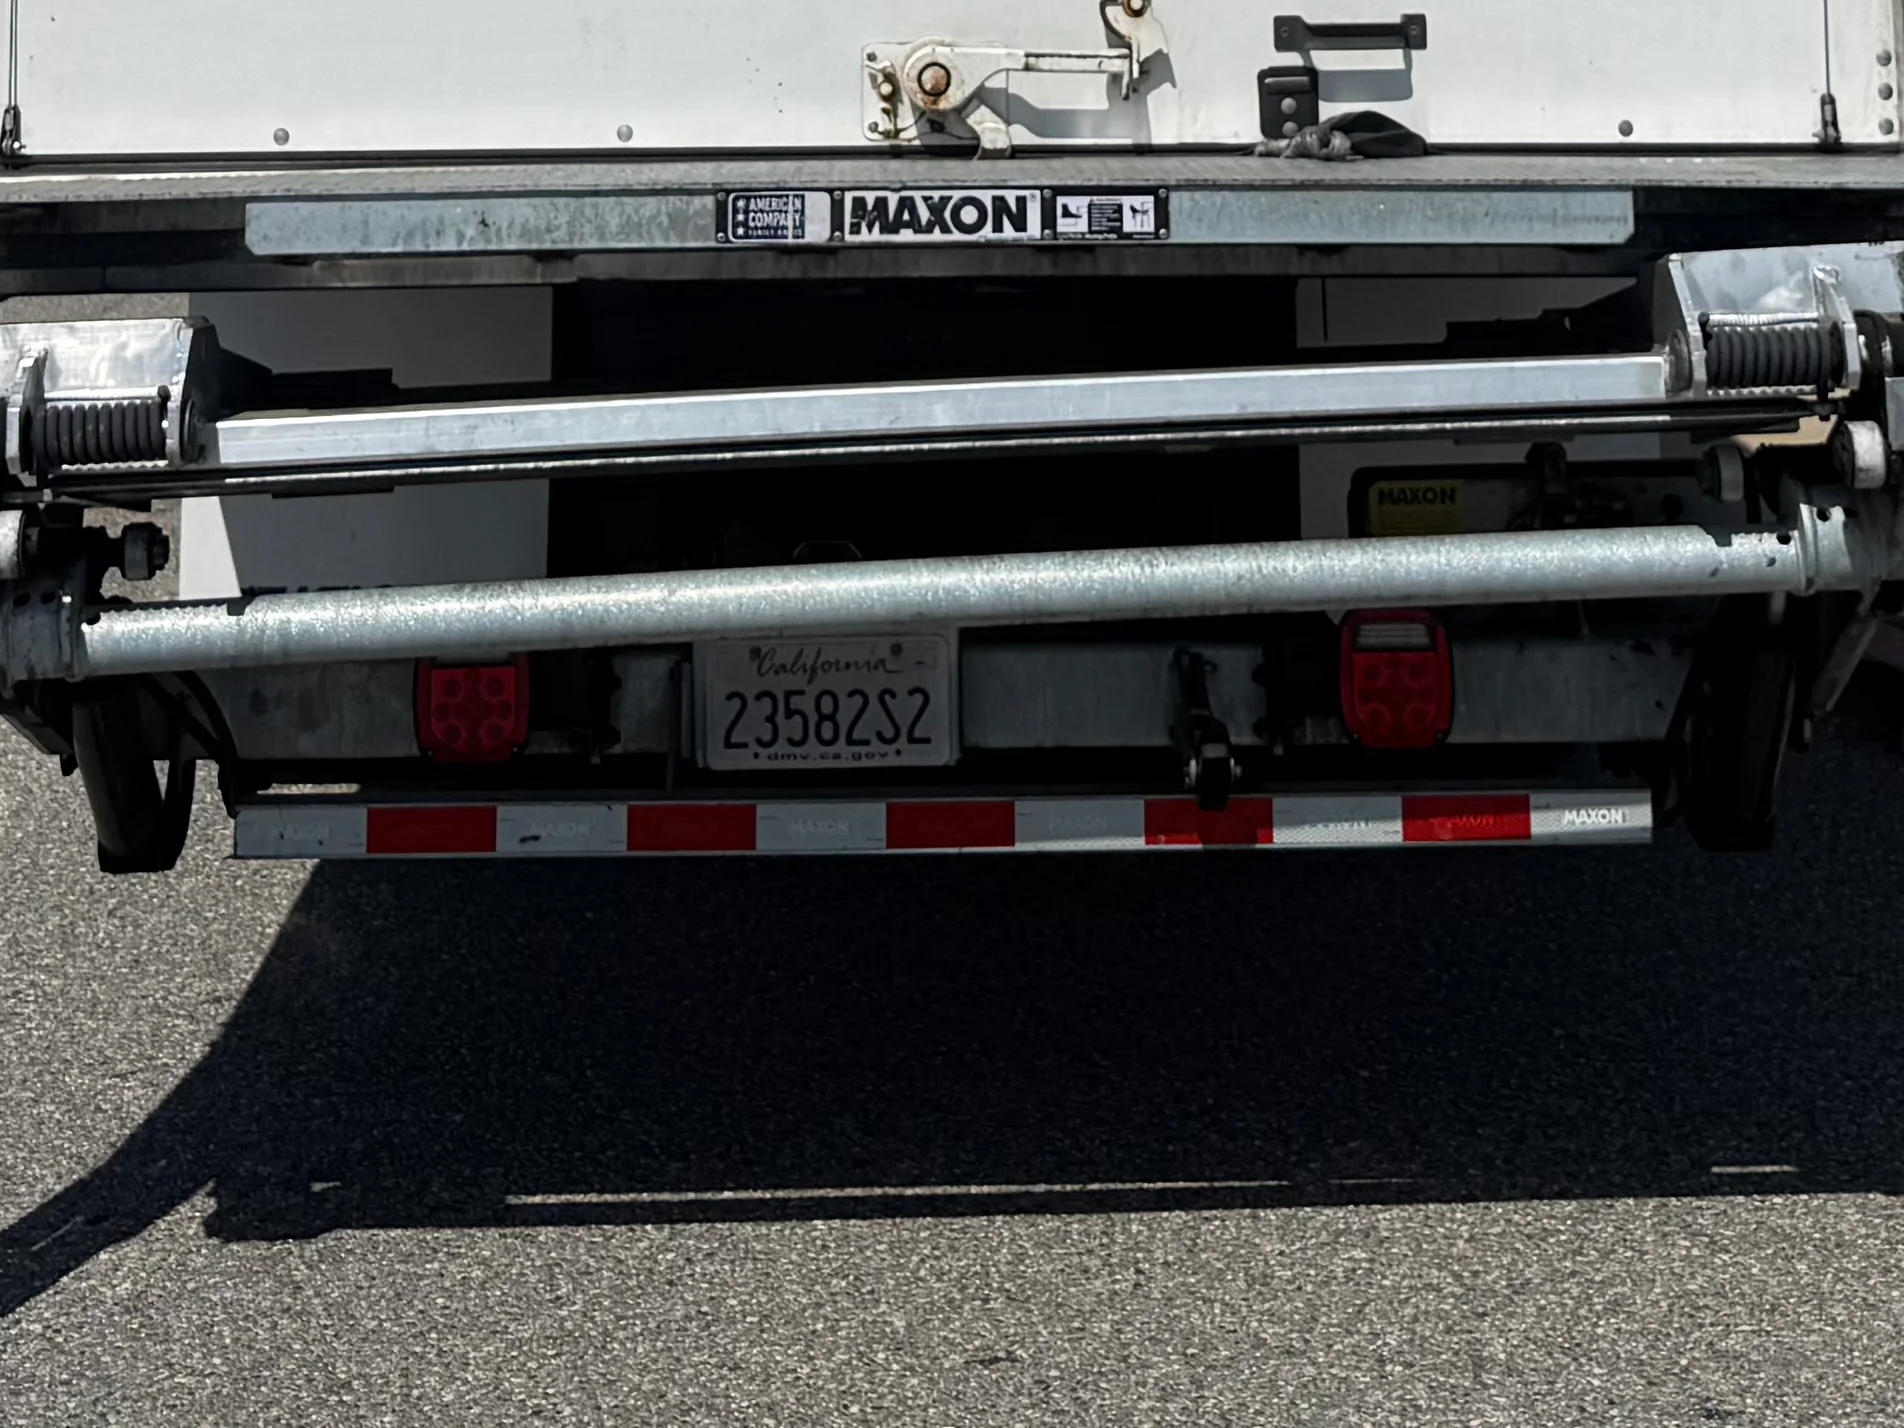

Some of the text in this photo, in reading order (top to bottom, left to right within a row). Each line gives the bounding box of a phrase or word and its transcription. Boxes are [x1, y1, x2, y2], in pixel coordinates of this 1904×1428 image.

[748, 197, 802, 211] AMERICN
[748, 211, 802, 227] COMPAY
[848, 196, 1028, 236] MAXON
[1378, 486, 1457, 505] MAXON
[757, 647, 903, 685] California
[724, 687, 933, 749] 23582S2
[767, 750, 889, 762] dmv.ca.gov
[1563, 808, 1623, 826] MAXON
